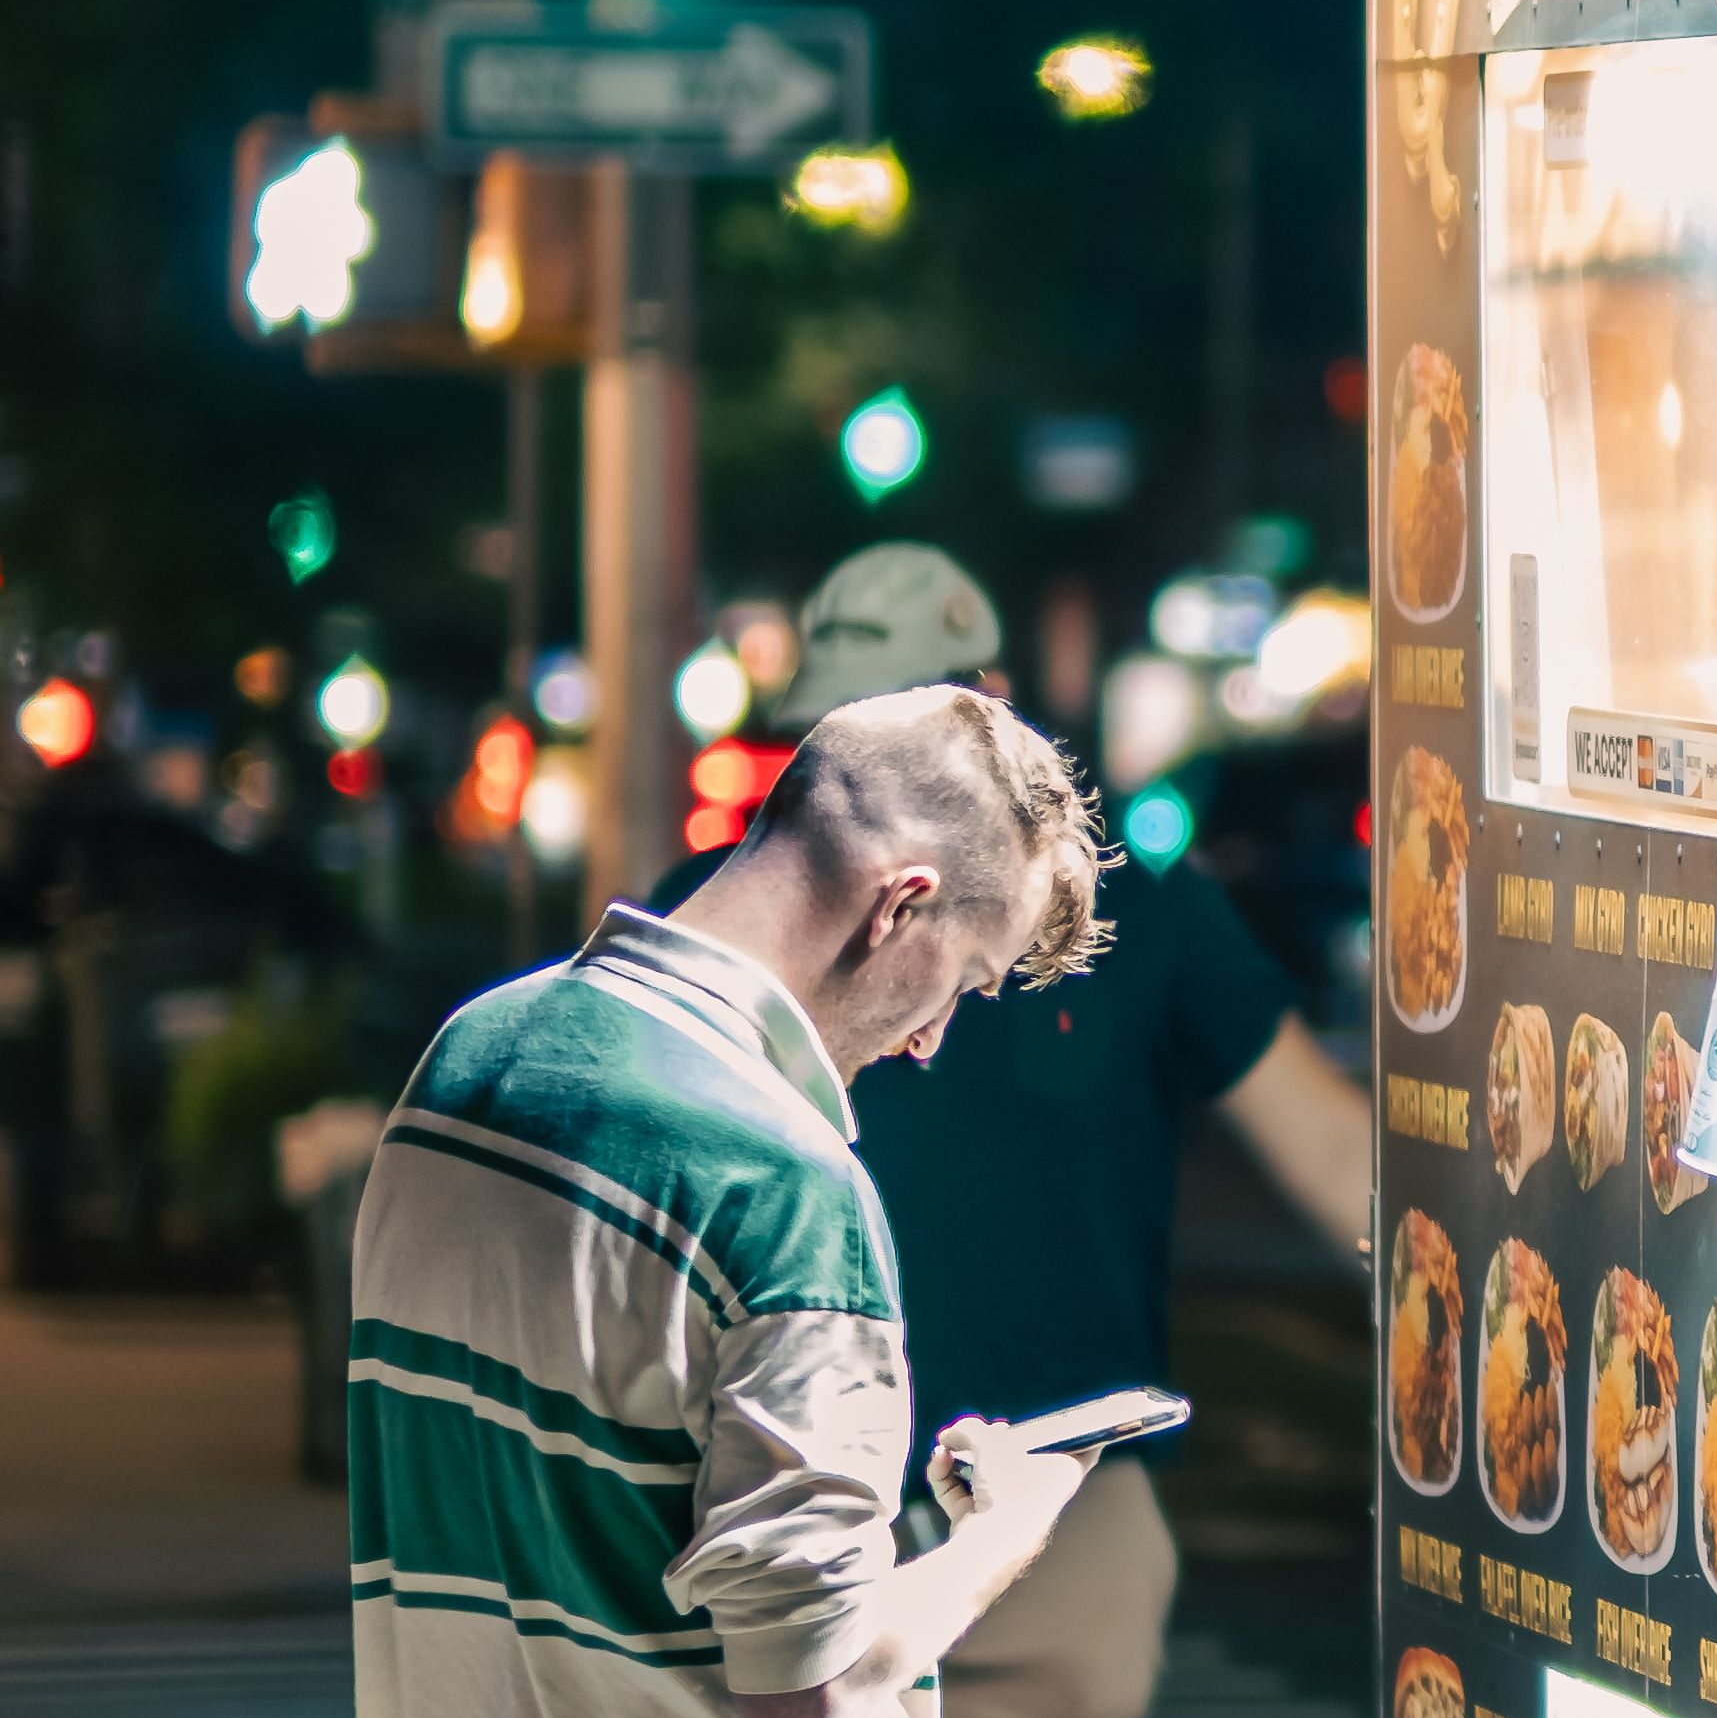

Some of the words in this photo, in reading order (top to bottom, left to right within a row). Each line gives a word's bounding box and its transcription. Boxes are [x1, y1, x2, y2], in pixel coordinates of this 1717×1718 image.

[1574, 729, 1591, 773] WE
[1593, 731, 1633, 781] ACCEPT
[1621, 1605, 1647, 1677] OVER
[1649, 1617, 1671, 1687] RICE
